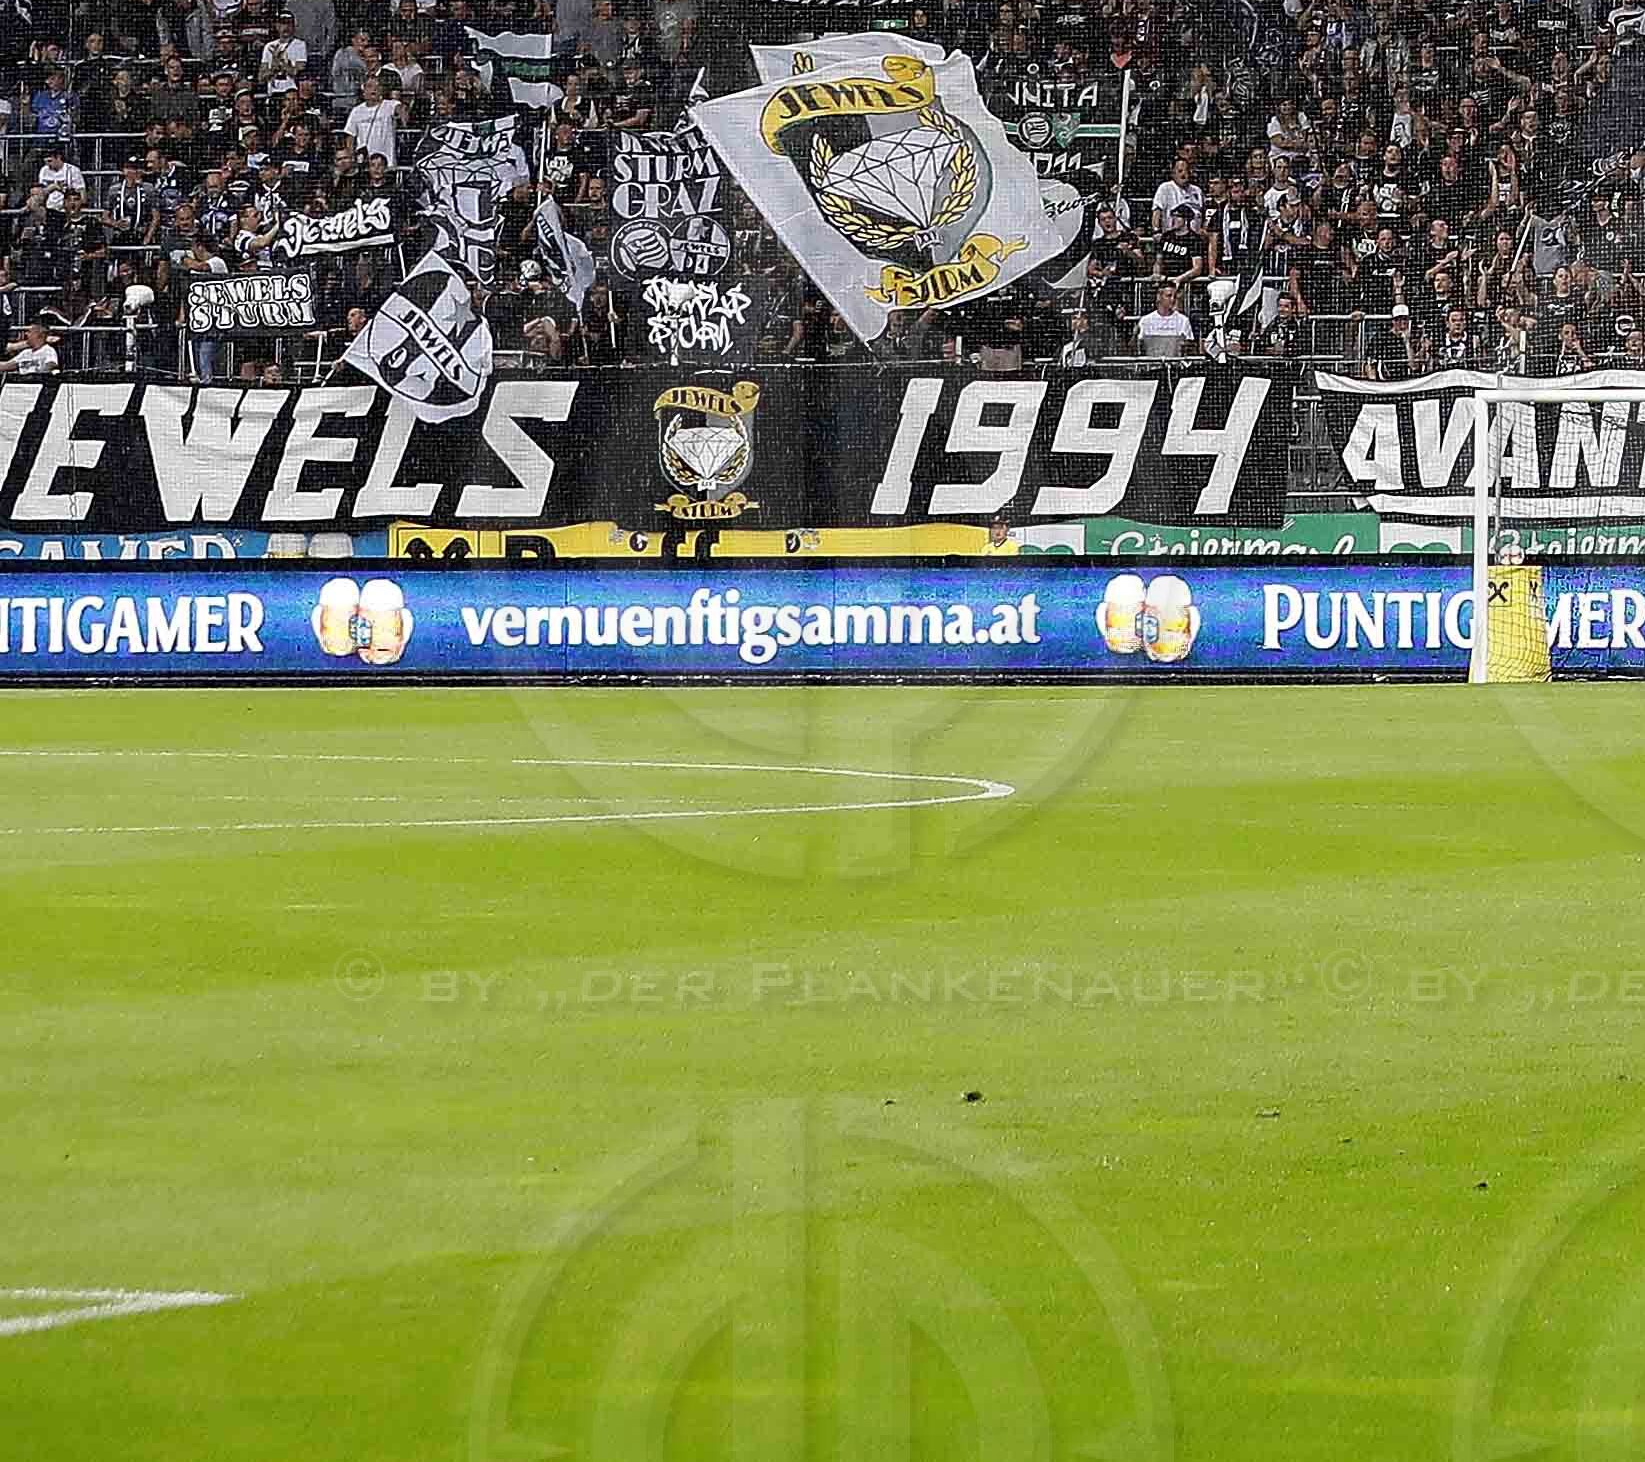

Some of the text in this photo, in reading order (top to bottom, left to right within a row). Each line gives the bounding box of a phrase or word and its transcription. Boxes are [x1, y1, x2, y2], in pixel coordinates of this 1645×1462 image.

[778, 81, 928, 119] JEWELS
[613, 150, 719, 184] STURM
[611, 177, 723, 220] GRAZ
[188, 274, 313, 306] JEWELS
[190, 301, 317, 333] STURM
[671, 388, 743, 414] JEWELS
[872, 377, 1271, 516] 1994
[463, 587, 1041, 665] vernuenftigsamma.at
